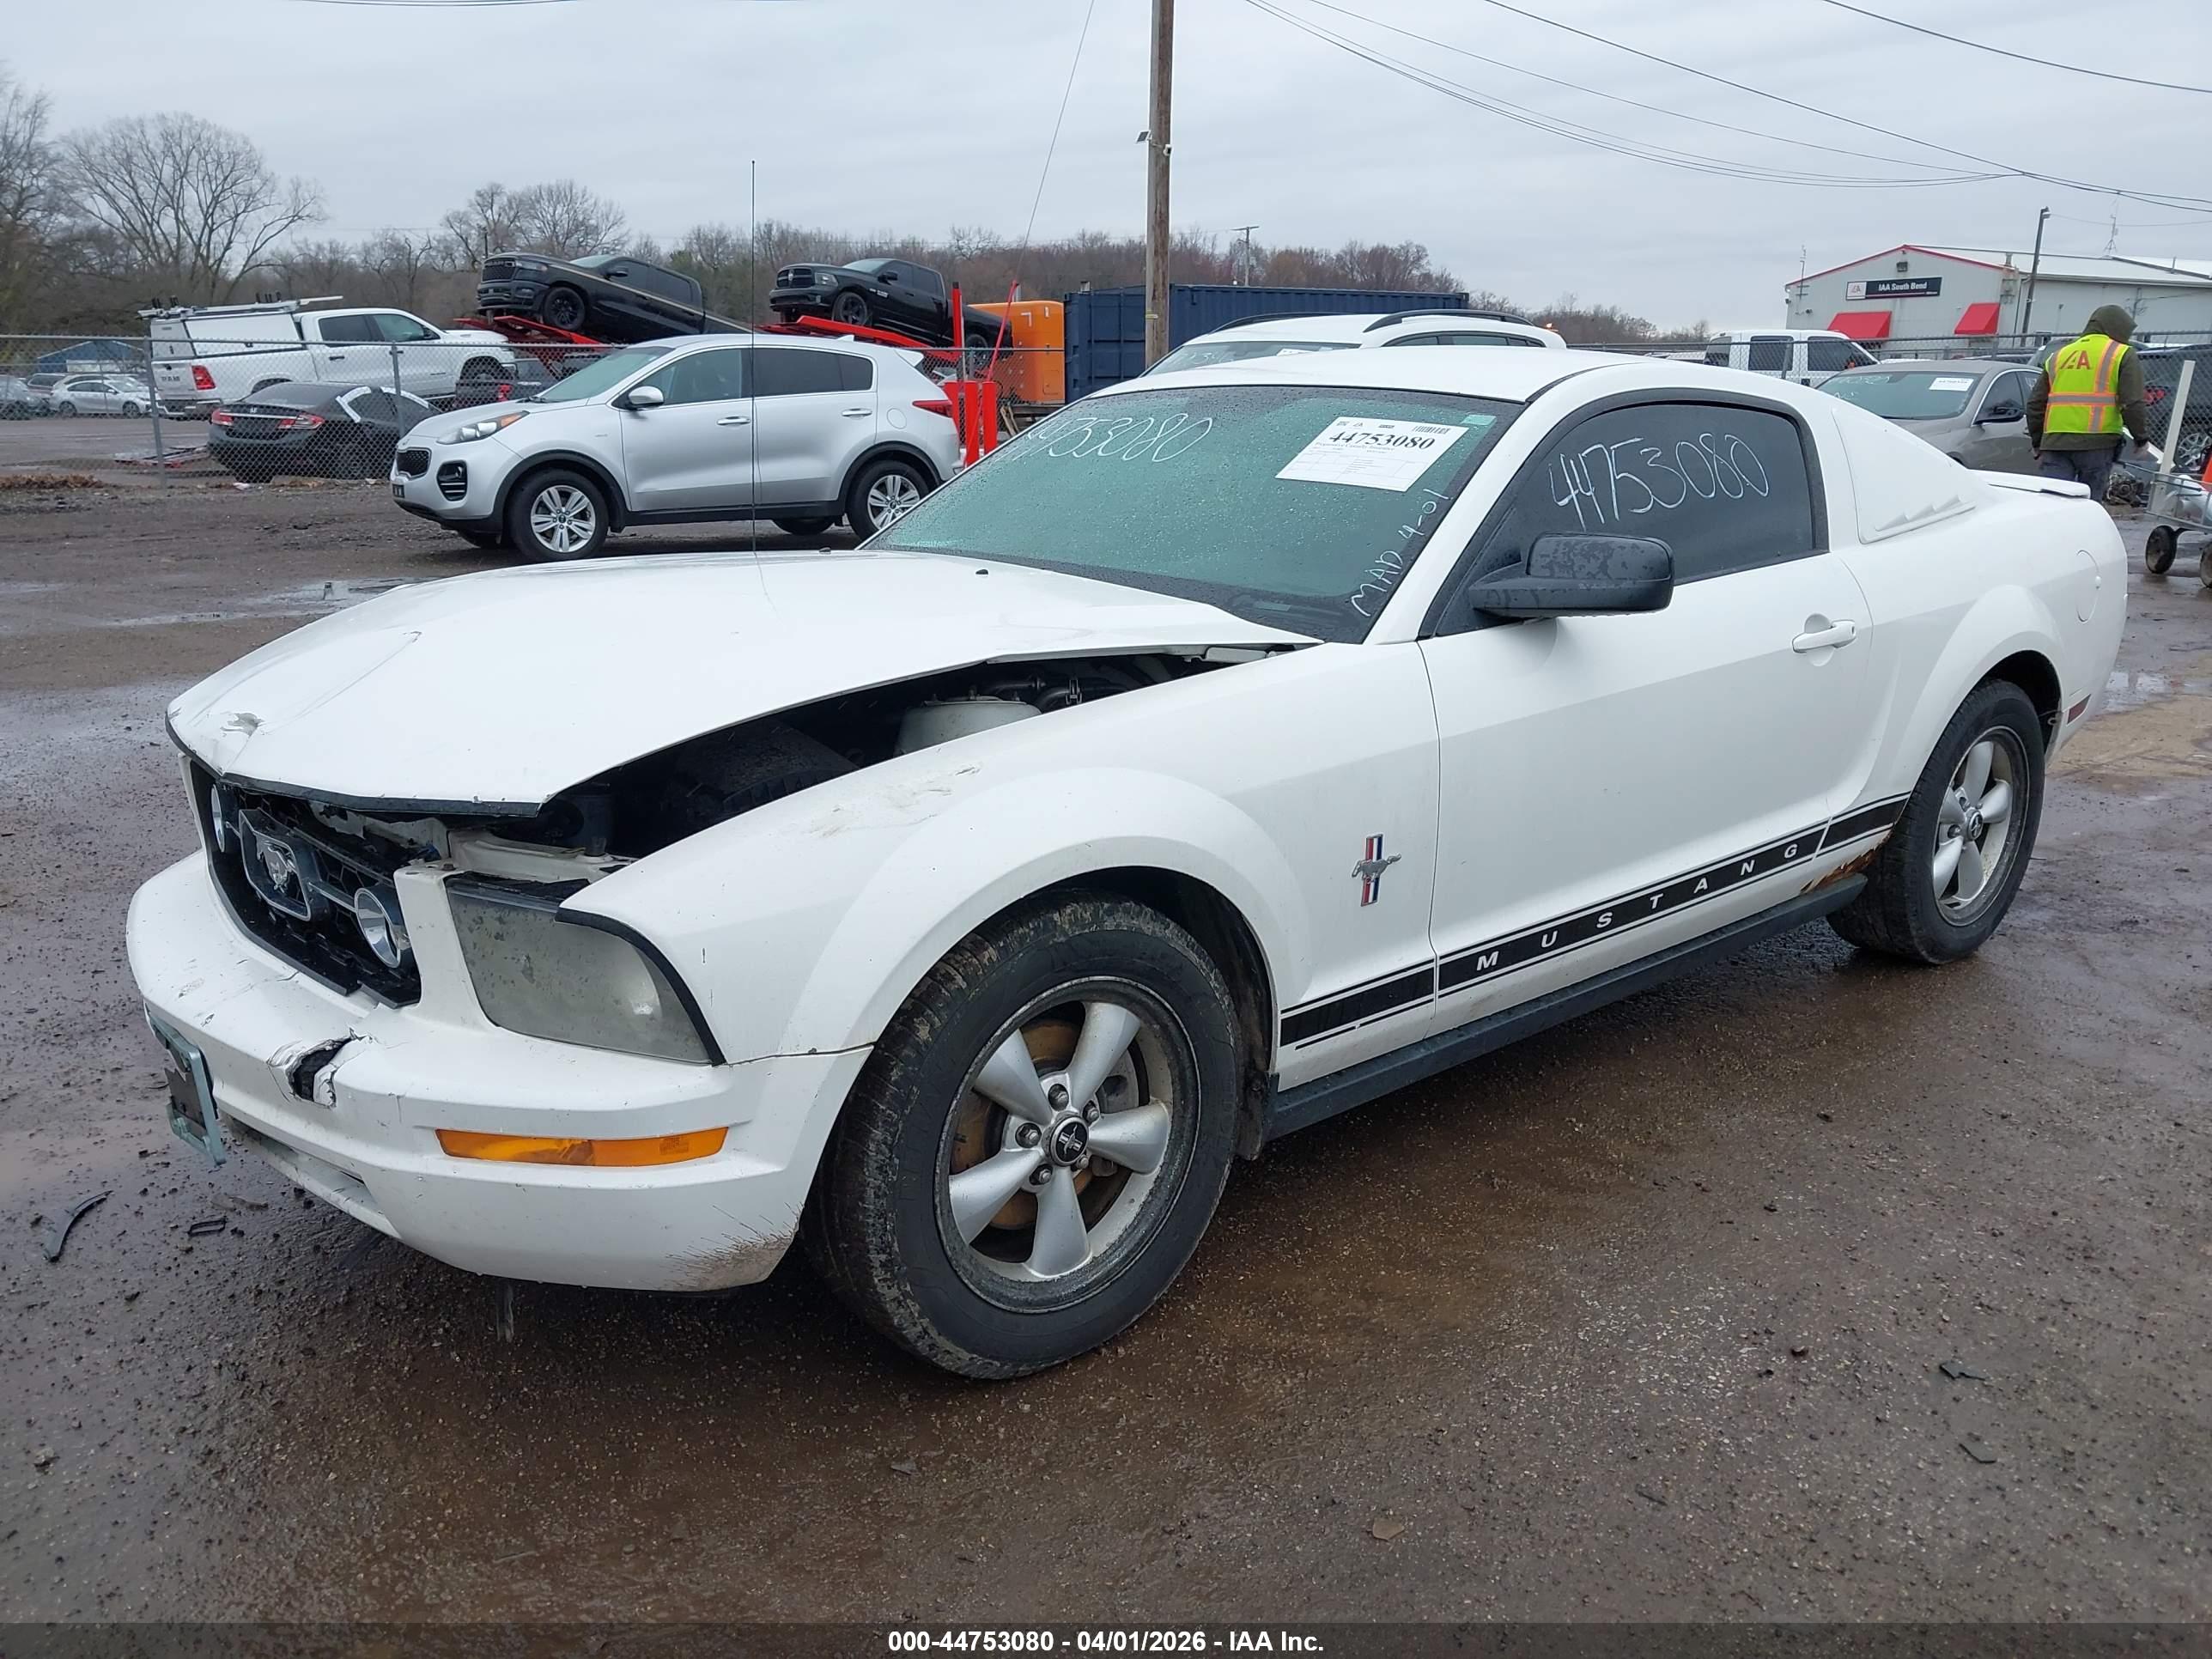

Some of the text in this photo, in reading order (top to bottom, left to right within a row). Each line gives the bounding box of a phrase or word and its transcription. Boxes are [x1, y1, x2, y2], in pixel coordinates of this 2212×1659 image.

[1892, 283, 1910, 291] South
[1329, 431, 1436, 450] 44753080
[1547, 432, 1770, 532] 44753080
[1351, 550, 1404, 617] MAD
[1475, 844, 1799, 972] MUSTANG
